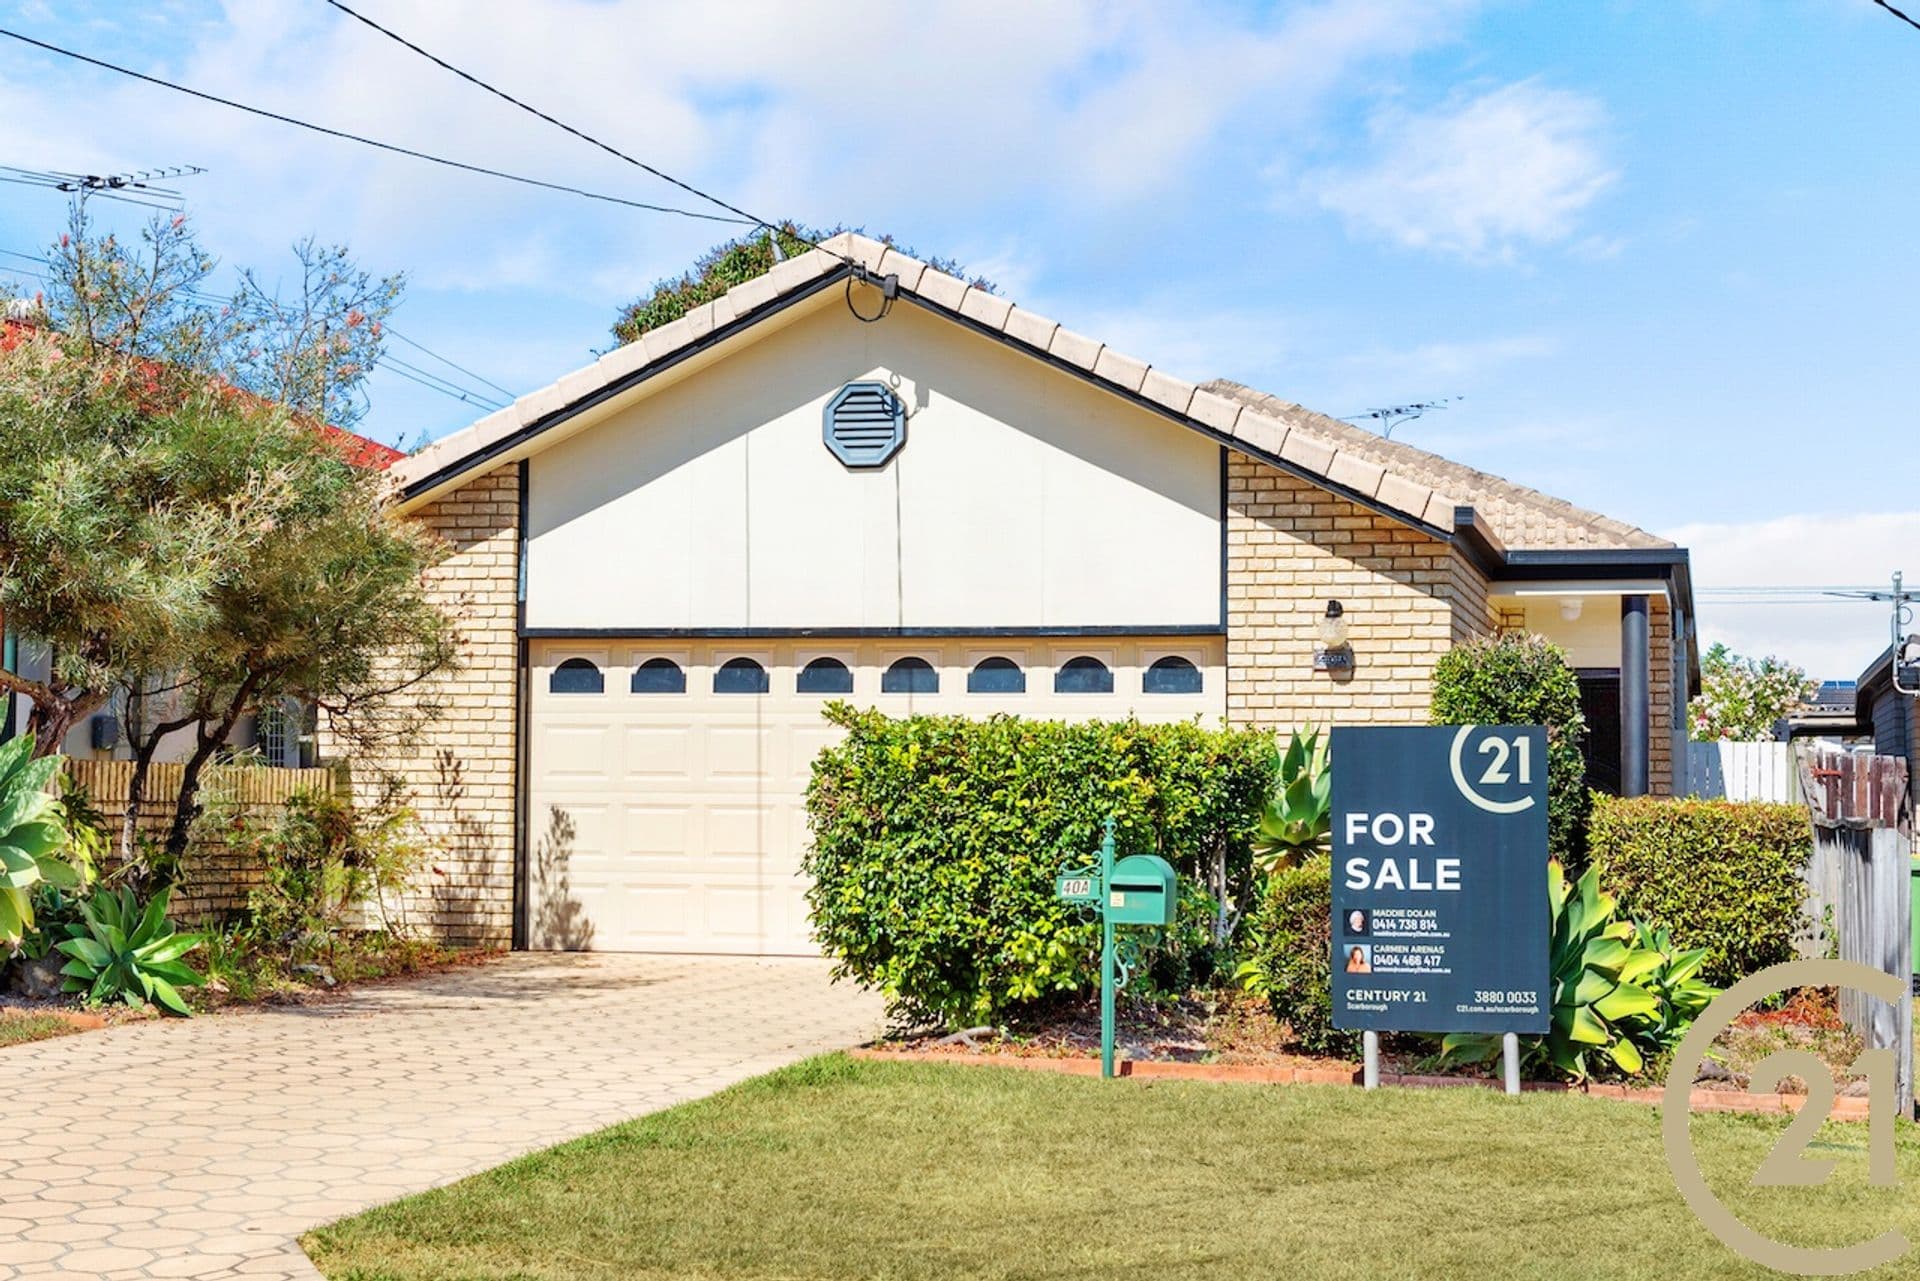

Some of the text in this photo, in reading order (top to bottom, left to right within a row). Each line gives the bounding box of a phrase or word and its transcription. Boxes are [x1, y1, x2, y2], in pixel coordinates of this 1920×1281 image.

[1346, 813, 1435, 845] FOR
[1345, 857, 1461, 890] SALE
[1063, 881, 1089, 894] 40A
[1372, 909, 1437, 918] MADDIE DOLAN
[1372, 919, 1437, 930] 0414 738 814
[1373, 945, 1445, 954] CARMEN ARENAS
[1373, 955, 1400, 966] 0404
[1424, 955, 1441, 967] 417
[1346, 989, 1410, 1002] CENTURY
[1474, 991, 1537, 1004] 3880 0033
[1346, 1002, 1388, 1012] Scarborough
